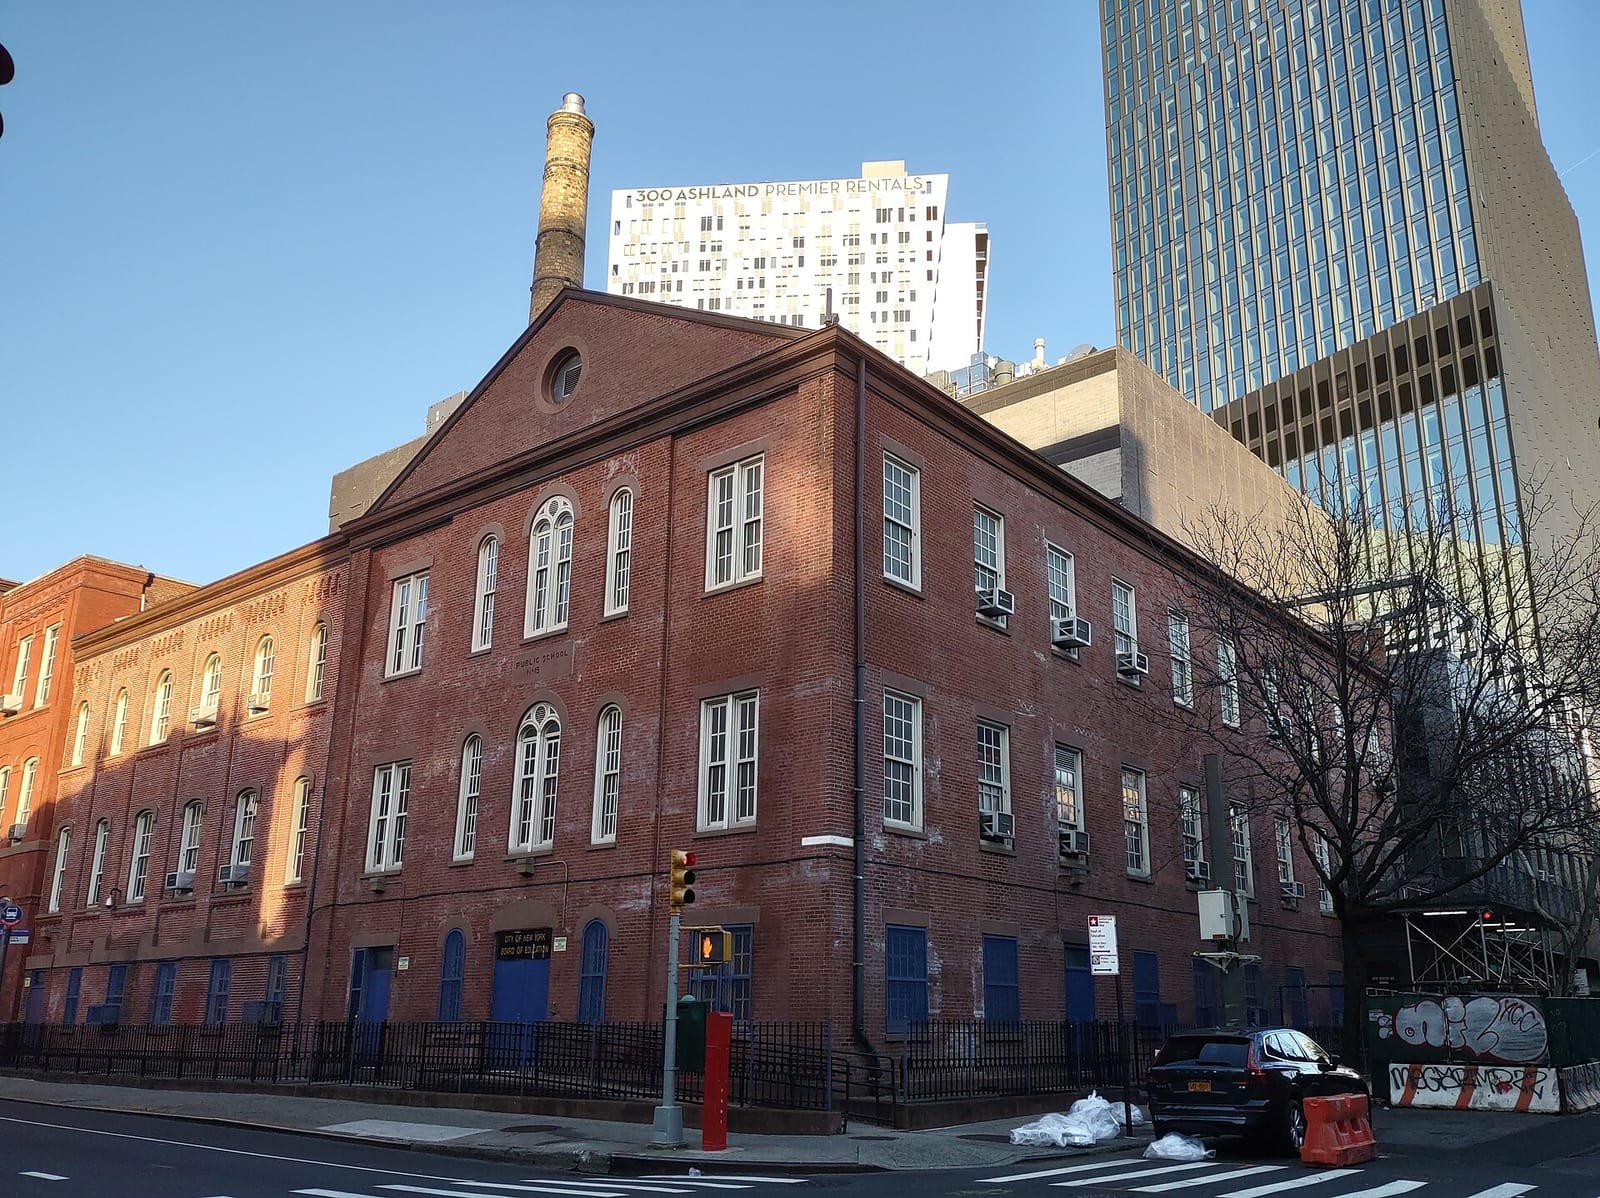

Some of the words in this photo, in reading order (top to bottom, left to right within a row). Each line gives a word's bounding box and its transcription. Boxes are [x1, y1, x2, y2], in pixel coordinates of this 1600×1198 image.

[636, 189, 673, 202] 300
[676, 185, 759, 200] ASHLAND
[765, 181, 840, 197] PREMIER
[846, 176, 923, 193] RENTALS
[516, 656, 540, 670] PUBLIC
[542, 650, 568, 662] SCHOOL
[504, 935, 514, 943] CITY
[515, 934, 522, 943] OF
[523, 933, 533, 942] NEW
[534, 931, 546, 941] YORK
[500, 946, 515, 956] BOARD
[516, 945, 523, 954] OF
[524, 945, 549, 954] EDUCATION
